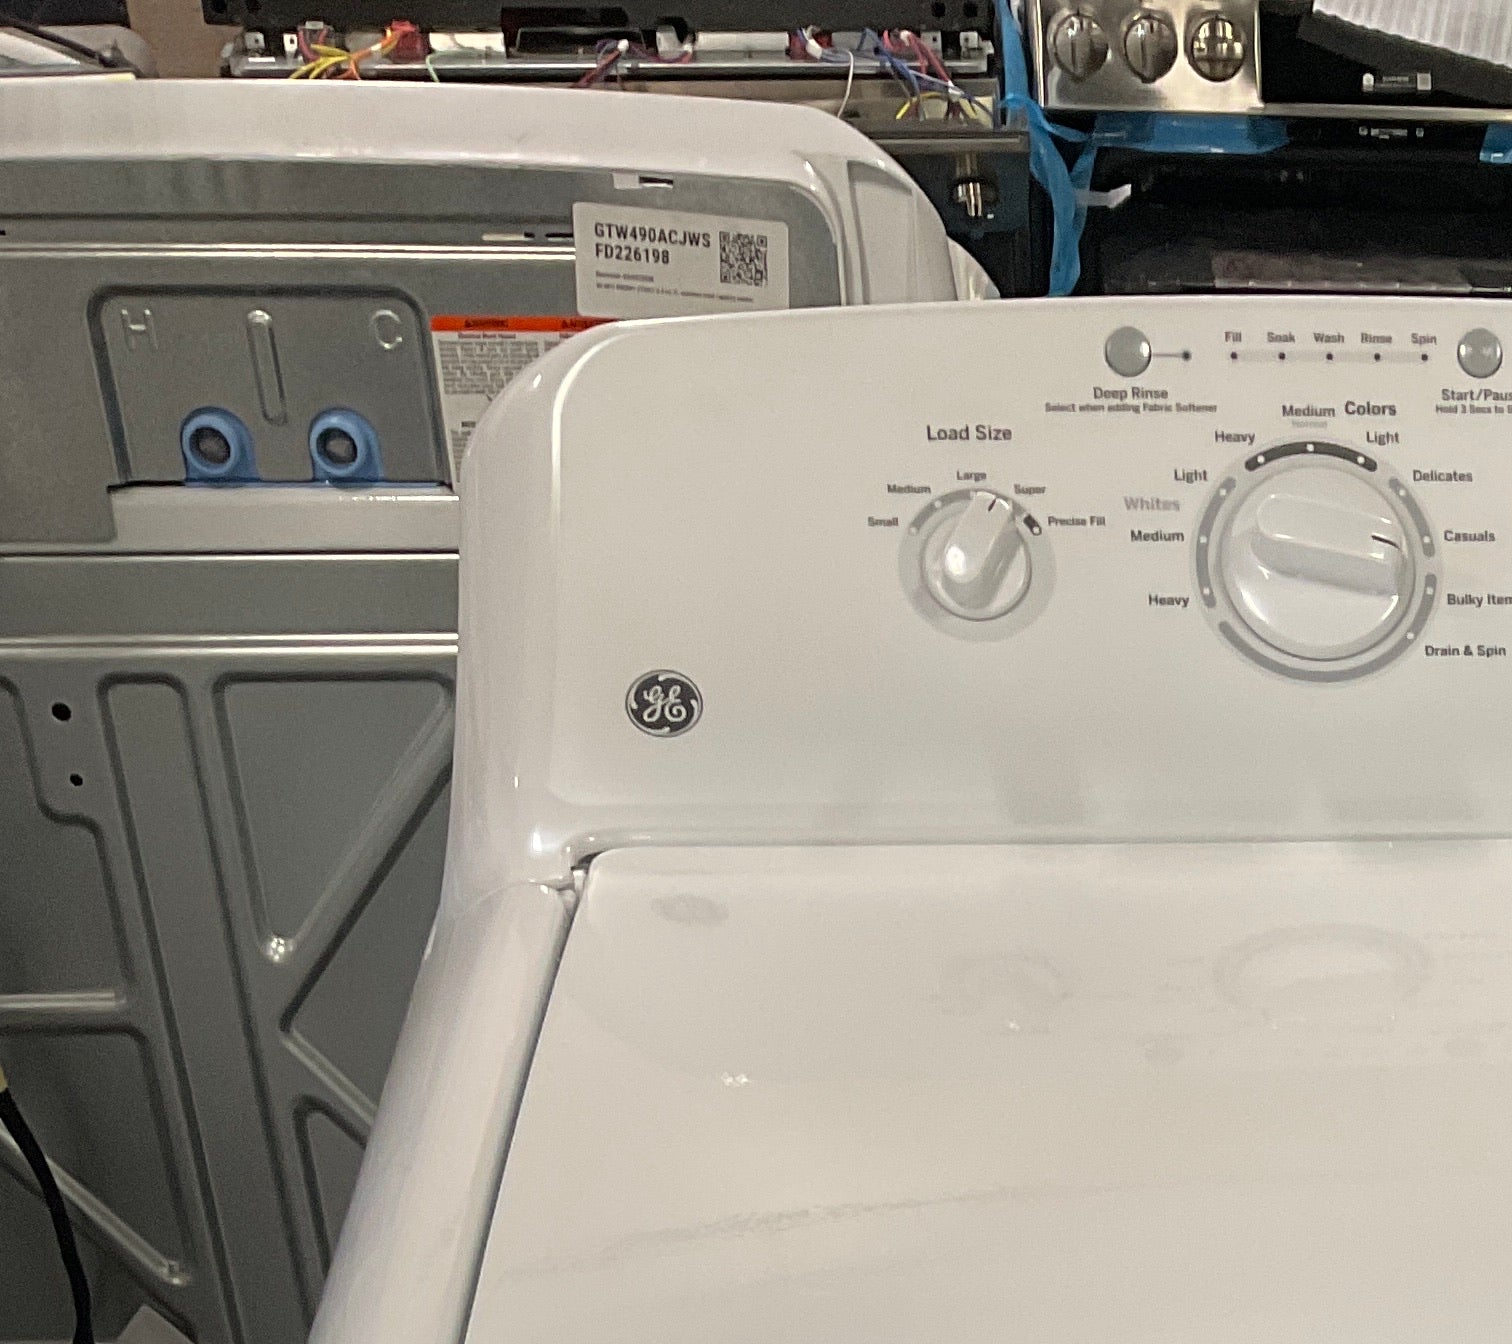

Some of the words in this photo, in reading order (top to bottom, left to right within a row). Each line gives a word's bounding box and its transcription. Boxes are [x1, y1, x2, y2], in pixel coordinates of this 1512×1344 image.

[594, 222, 711, 249] GTW490ACJWS
[595, 243, 670, 264] FD226198
[1225, 331, 1242, 343] Fill
[1267, 331, 1295, 344] Soak
[1313, 332, 1345, 344] Wash
[1361, 332, 1393, 344] Rinse
[1411, 333, 1437, 347] Spin
[1093, 386, 1128, 401] Deep
[1132, 387, 1169, 400] Rinse
[1282, 404, 1336, 418] Medium
[1345, 400, 1397, 416] Colors
[927, 424, 970, 441] Load
[975, 424, 1012, 441] Size
[1215, 431, 1256, 446] Heavy
[1366, 431, 1400, 446] Light
[956, 471, 987, 482] Large
[1174, 469, 1208, 484] Light
[1412, 470, 1473, 482] Delicates
[887, 484, 931, 494] Medium
[1014, 484, 1046, 495] Super
[1124, 496, 1180, 511] Whites
[868, 516, 899, 527] Small
[1048, 516, 1087, 526] Precise
[1090, 516, 1106, 526] Fill
[1130, 530, 1185, 542] Medium
[1444, 530, 1496, 542] Casuals
[1148, 594, 1190, 608] Heavy
[1447, 593, 1483, 608] Bulky
[1425, 645, 1460, 657] Drain
[1463, 645, 1473, 656] &
[1477, 645, 1506, 658] Spin
